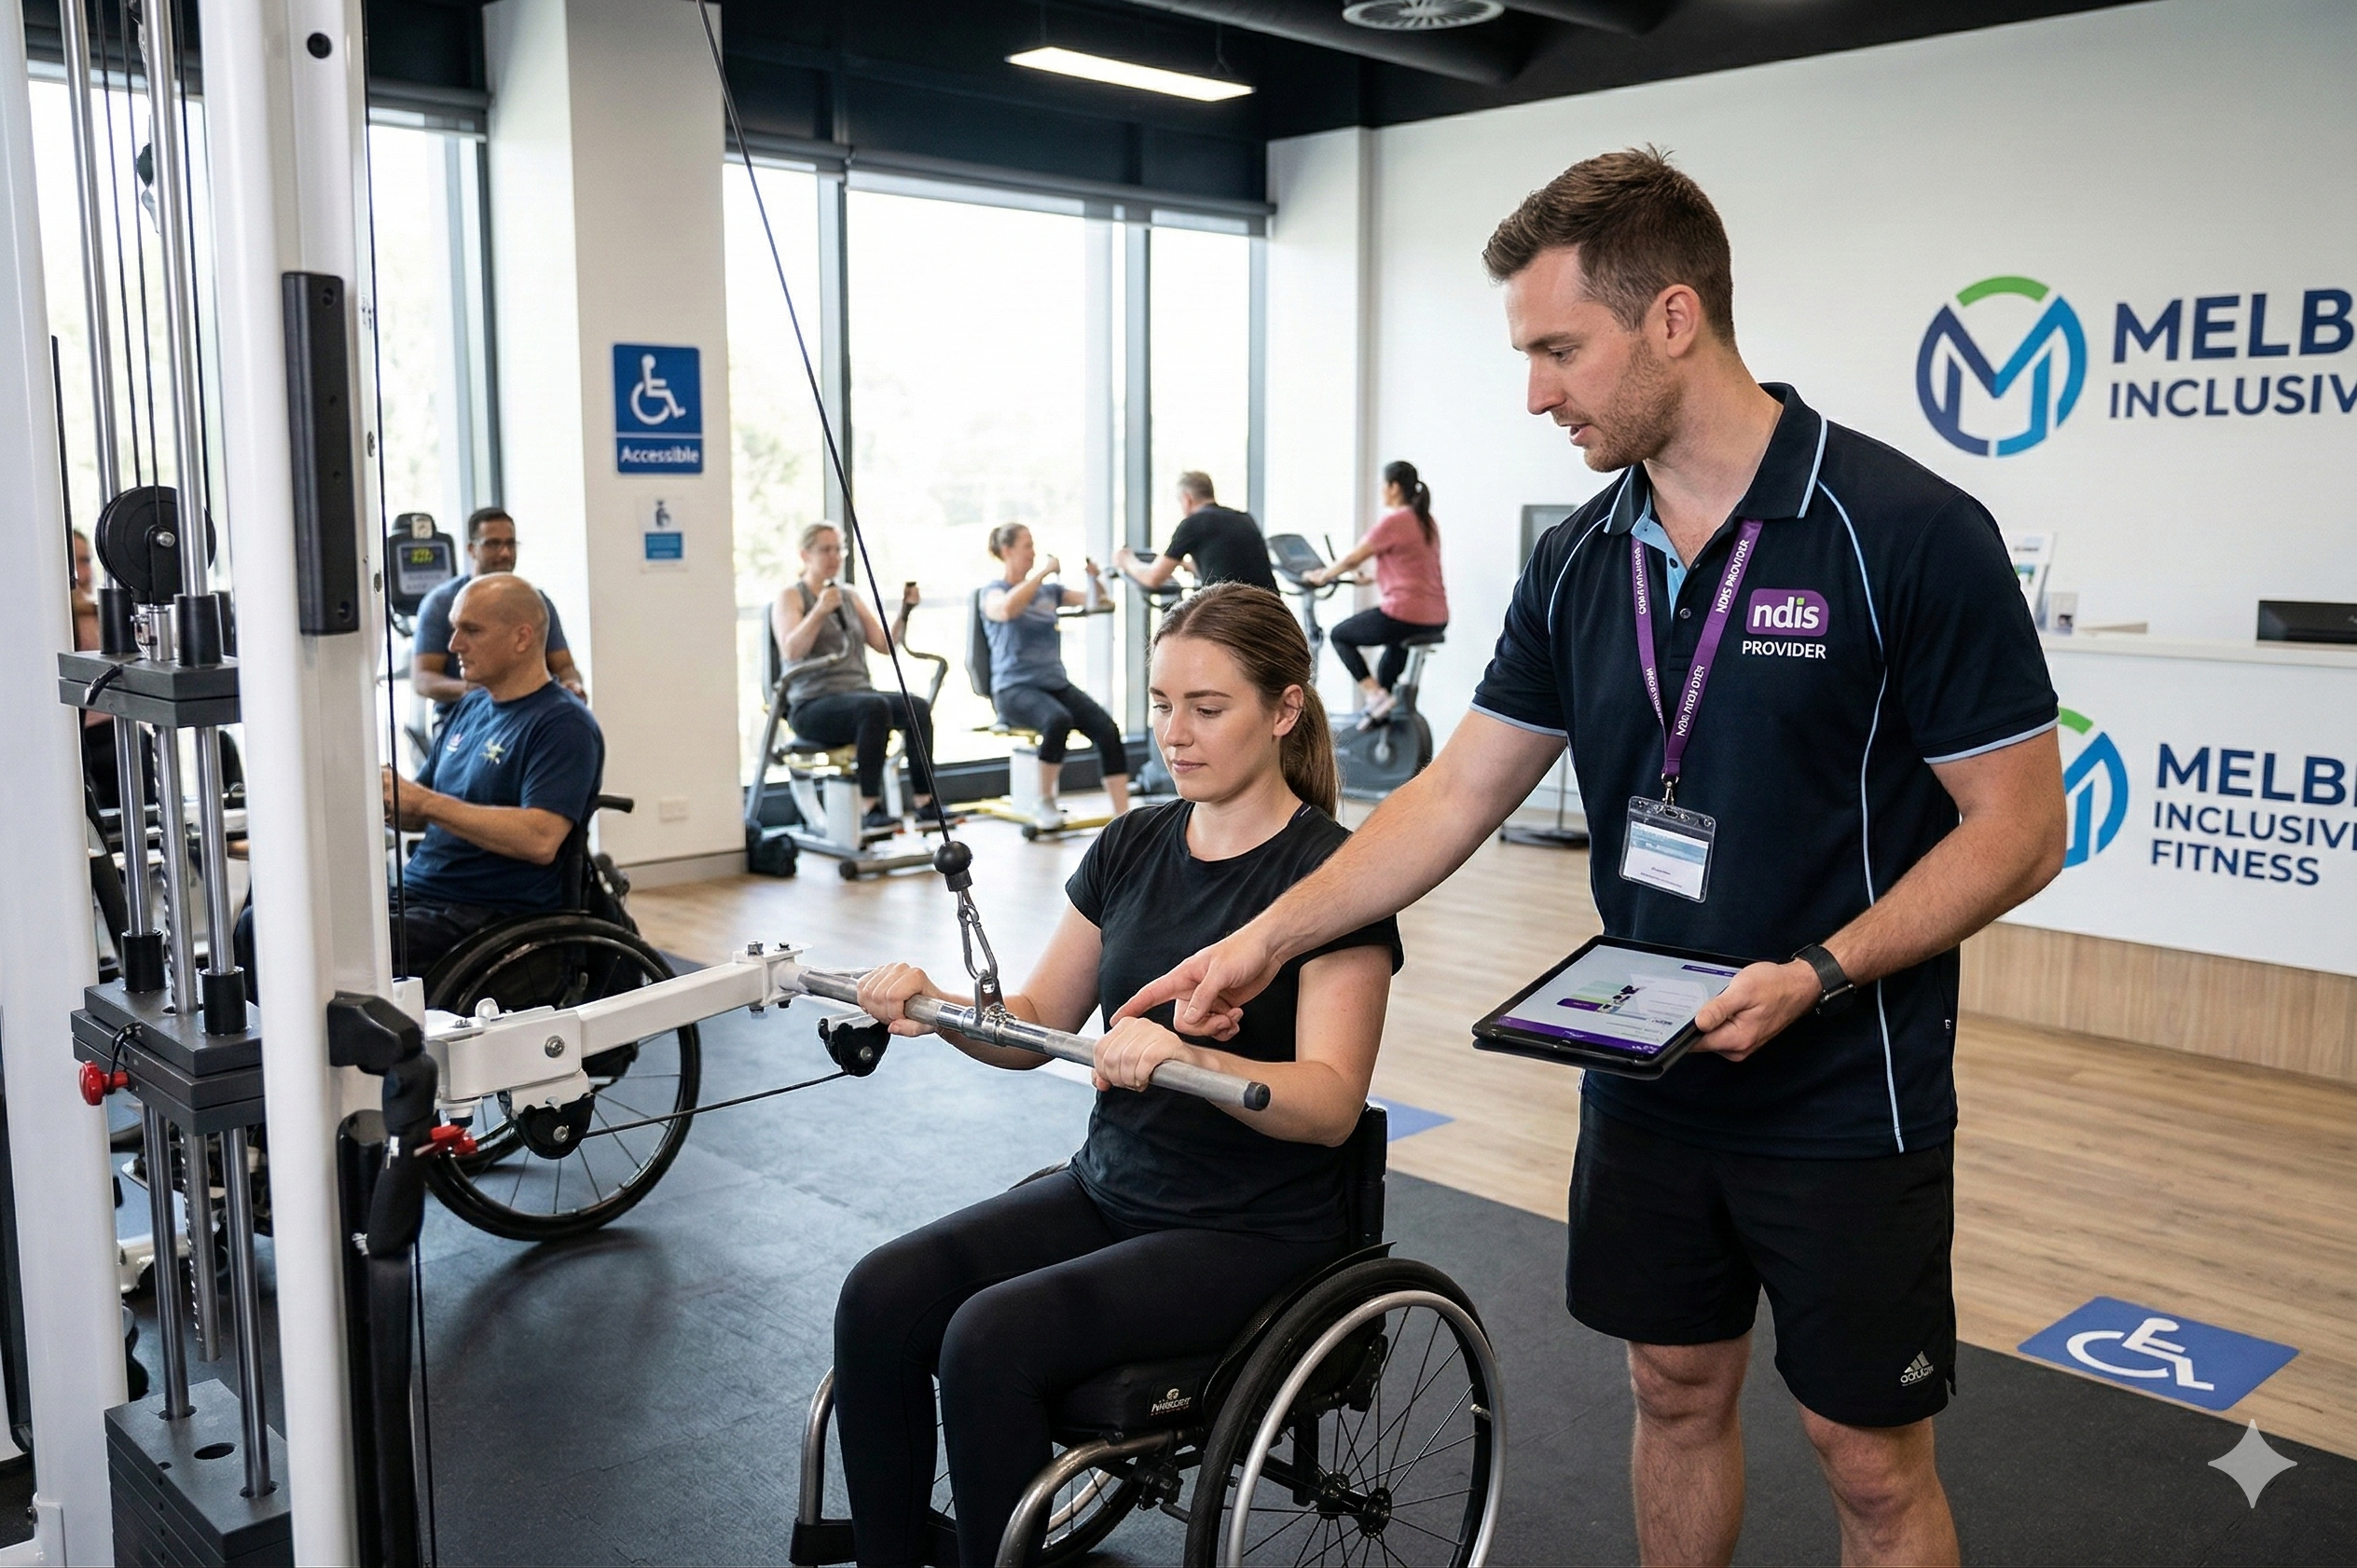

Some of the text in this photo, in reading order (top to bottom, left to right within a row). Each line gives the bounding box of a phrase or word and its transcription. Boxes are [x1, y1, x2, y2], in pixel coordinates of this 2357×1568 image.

[2113, 288, 2354, 364] MELB
[2110, 374, 2357, 418] INCLUSIV
[620, 446, 699, 464] Accessible
[1715, 587, 1732, 613] NDIS
[1753, 596, 1820, 629] ndis
[1742, 640, 1826, 660] PROVIDER
[2157, 743, 2357, 807] MELB
[2152, 839, 2320, 887] FITNESS
